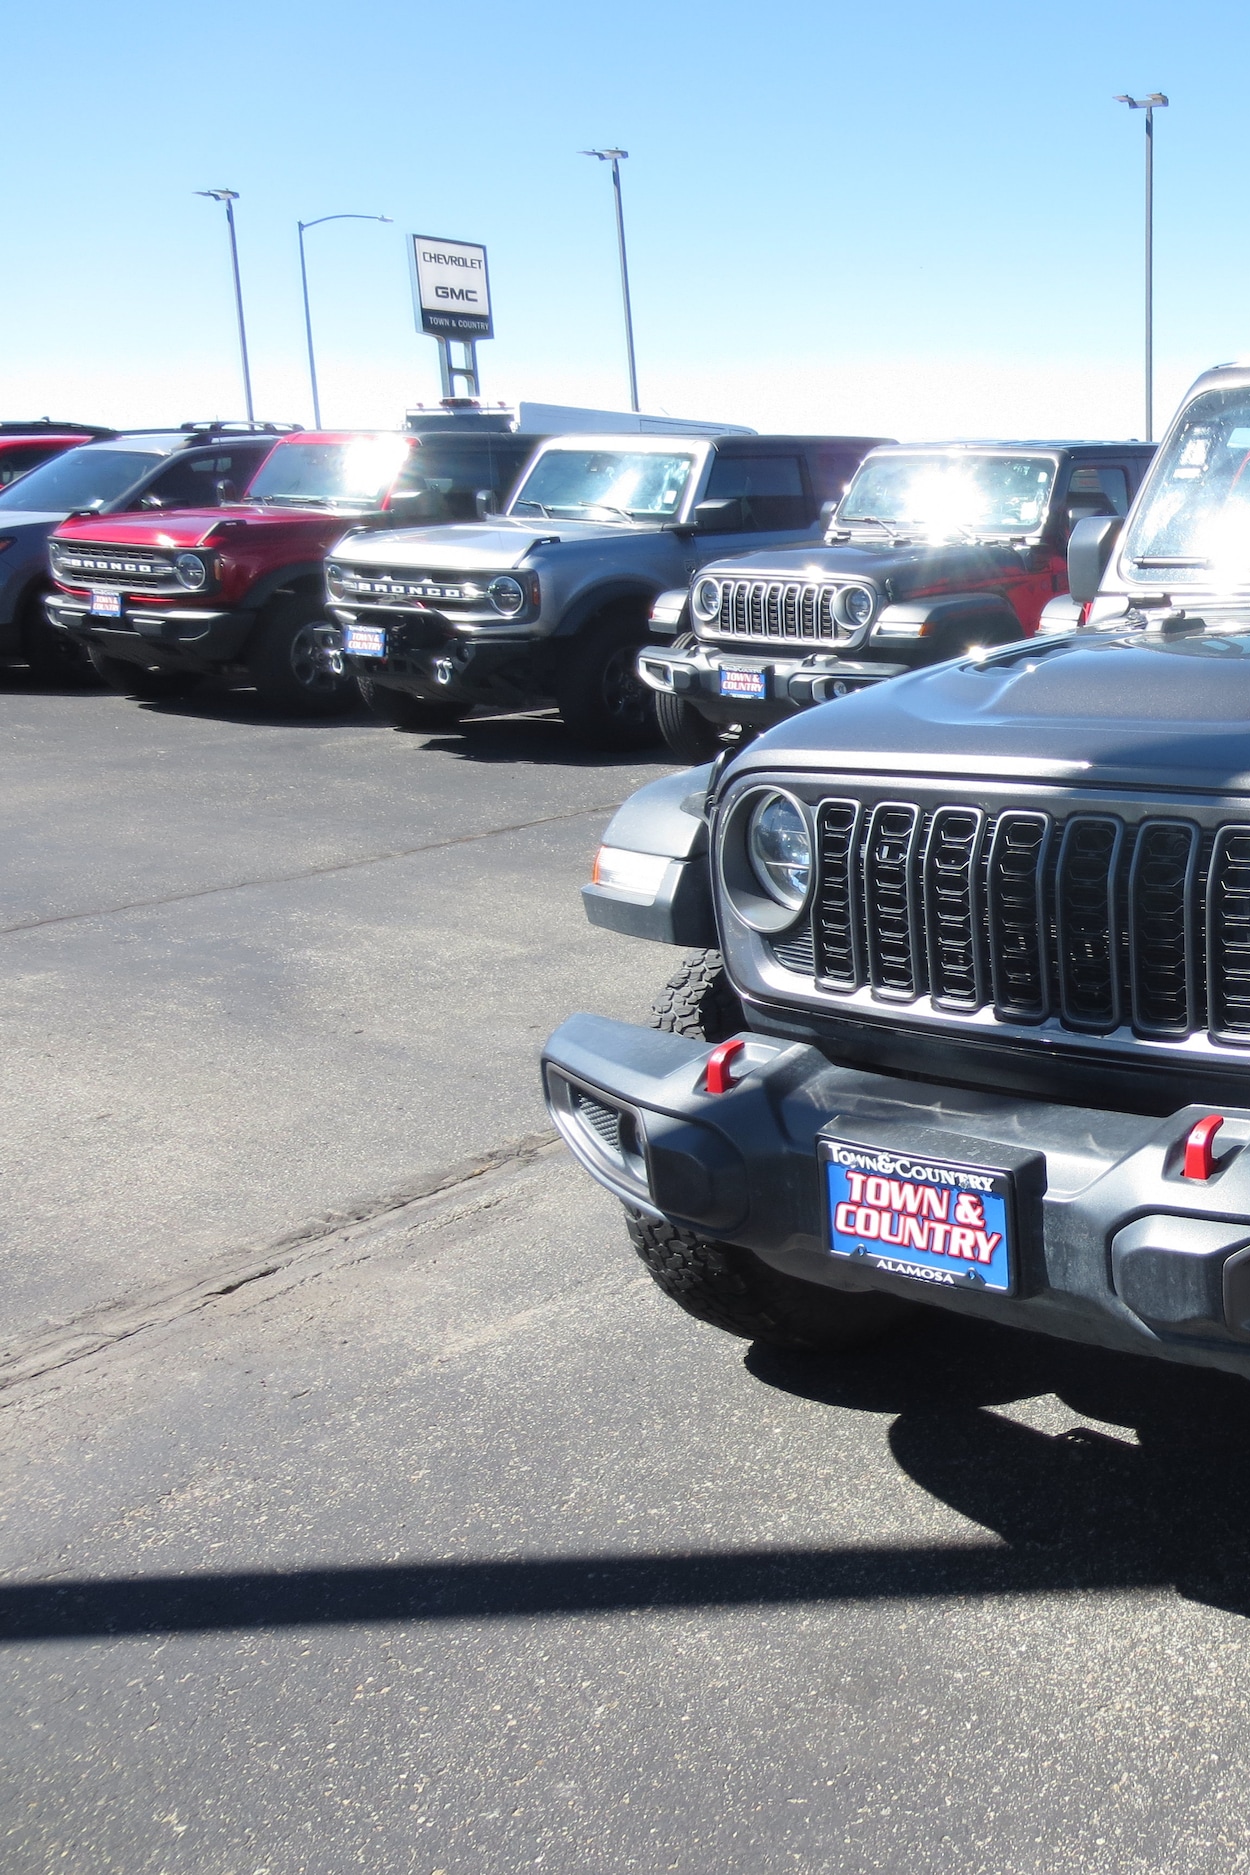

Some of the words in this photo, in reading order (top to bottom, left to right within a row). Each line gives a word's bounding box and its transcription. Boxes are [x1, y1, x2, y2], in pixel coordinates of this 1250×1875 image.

[422, 251, 483, 270] CHEVROLET
[435, 285, 478, 303] GMC
[429, 316, 450, 327] TOWN
[451, 319, 457, 328] &
[458, 319, 489, 331] COUNTRY
[71, 558, 152, 573] BRONCO
[358, 582, 460, 598] BRONCO
[352, 632, 374, 642] TOWN
[348, 640, 383, 651] COUNTRY
[725, 671, 751, 682] TOWN
[752, 674, 760, 684] &
[722, 680, 764, 693] COUNTRY
[846, 1170, 950, 1220] TOWN
[953, 1191, 986, 1228] &
[835, 1201, 1002, 1265] COUNTRY
[876, 1259, 955, 1285] ALAMOSA
